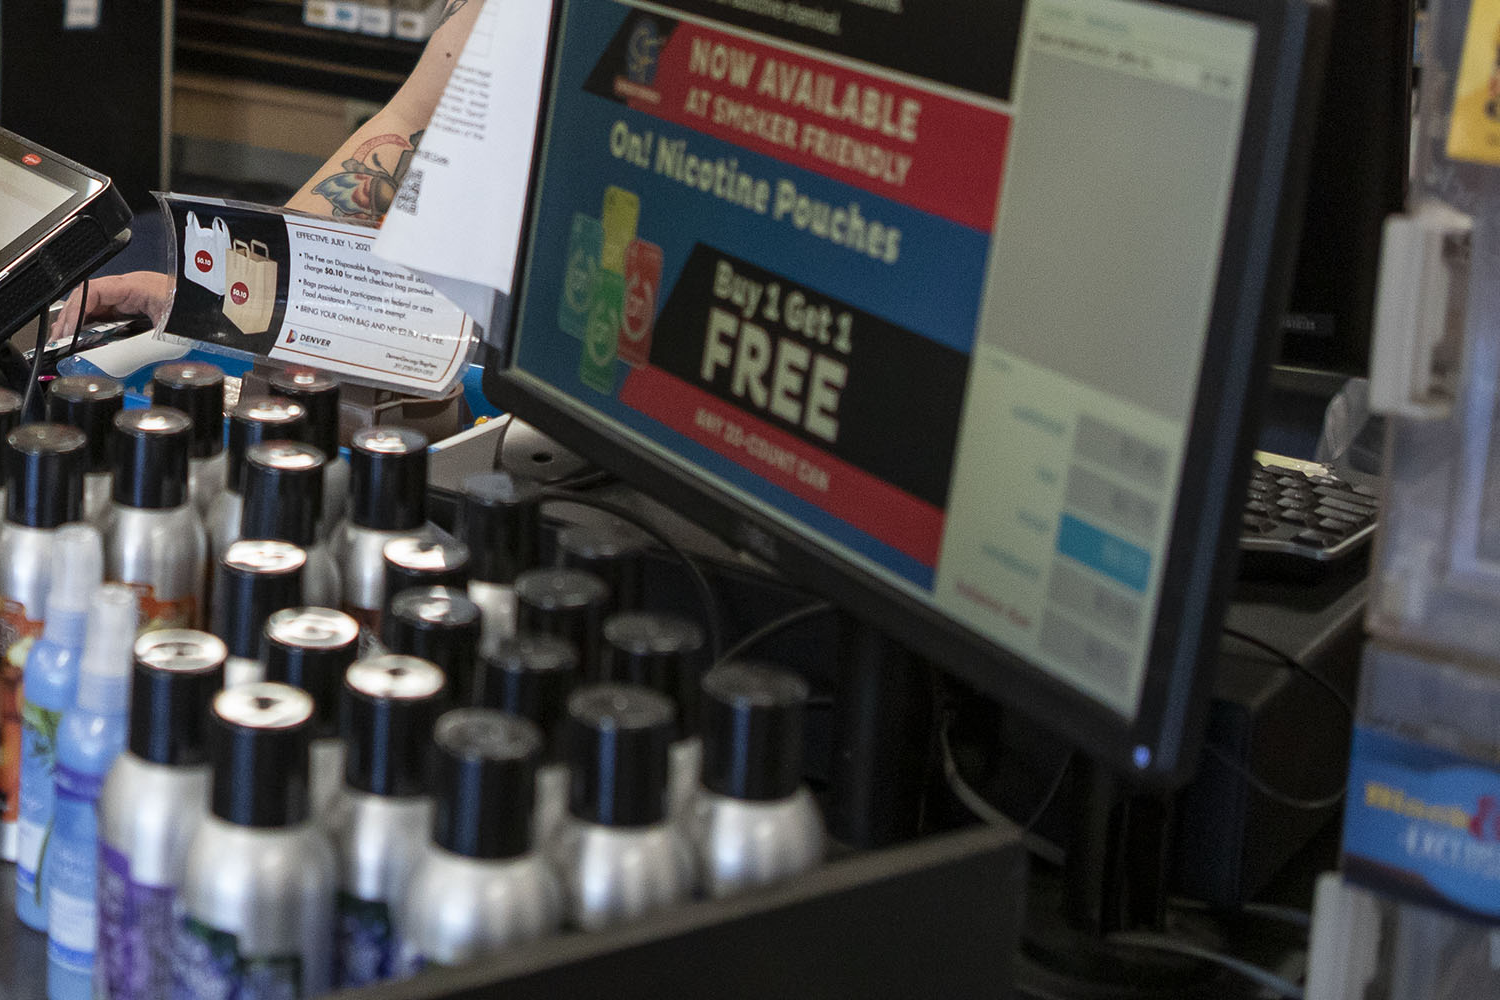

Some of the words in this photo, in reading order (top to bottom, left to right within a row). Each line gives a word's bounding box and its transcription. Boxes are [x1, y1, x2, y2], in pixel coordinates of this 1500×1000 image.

[687, 36, 758, 89] NOW
[757, 53, 924, 143] AVAILABLE
[683, 89, 712, 117] AT
[712, 95, 799, 149] SMOKER
[803, 124, 913, 186] FRIENDLY
[609, 120, 653, 169] On!
[654, 136, 771, 215] Nicotine
[773, 179, 902, 265] Pouches
[195, 256, 213, 268] $0.10
[296, 230, 329, 245] EFFECTIVE
[331, 237, 346, 247] JULY
[355, 241, 372, 251] 2021
[324, 266, 344, 278] $0.10
[300, 303, 319, 317] BRING
[320, 309, 338, 321] YOUR
[338, 312, 356, 325] OWN
[356, 317, 370, 329] BAG
[712, 259, 764, 320] Buy
[762, 282, 781, 322] 1
[783, 292, 833, 346] Get
[834, 311, 853, 355] 1
[300, 333, 332, 348] DENVER
[701, 306, 849, 445] FREE
